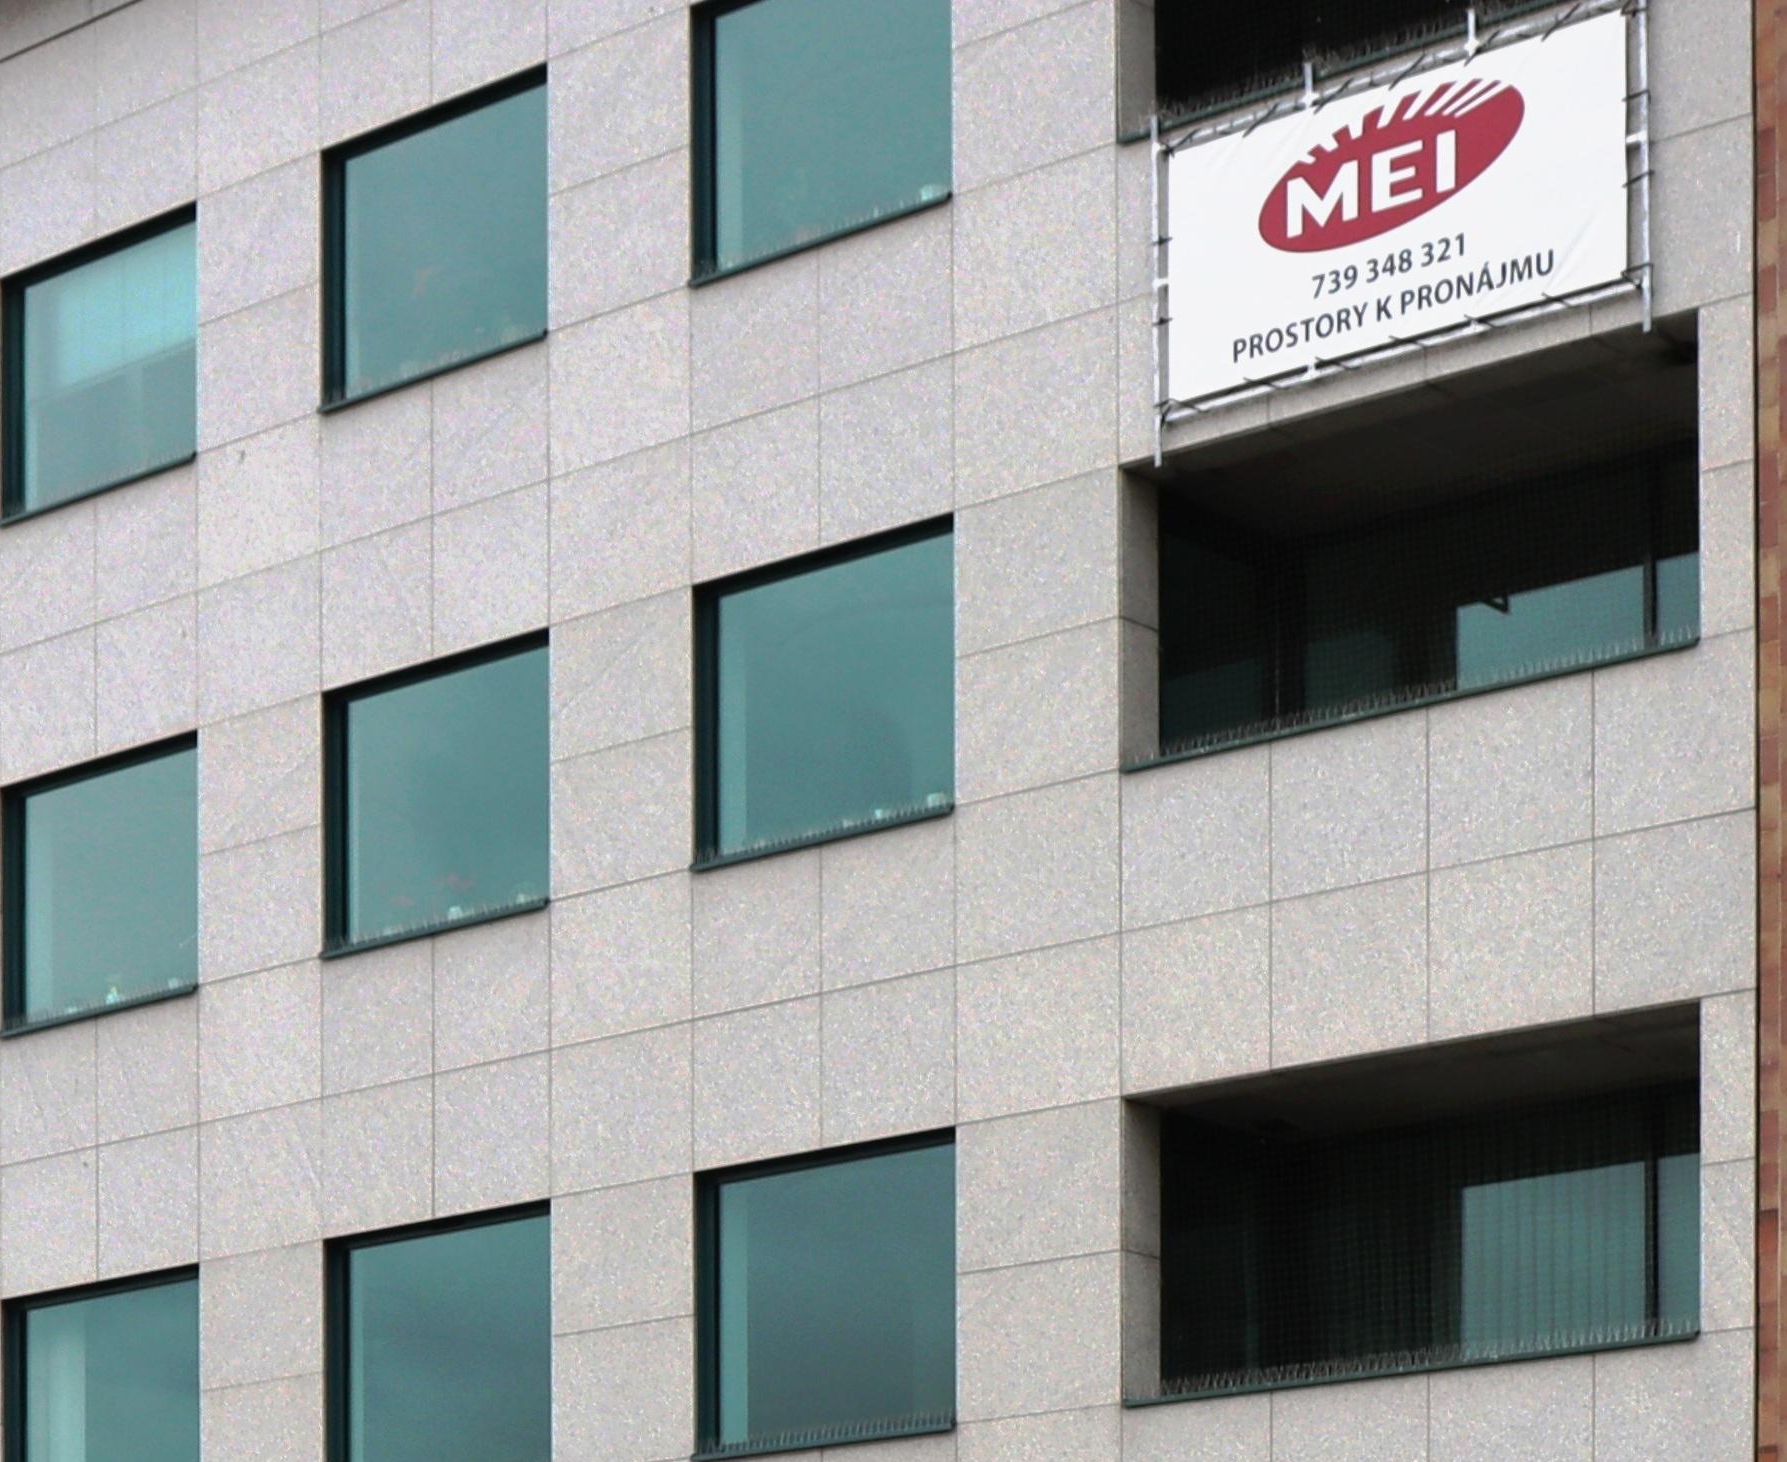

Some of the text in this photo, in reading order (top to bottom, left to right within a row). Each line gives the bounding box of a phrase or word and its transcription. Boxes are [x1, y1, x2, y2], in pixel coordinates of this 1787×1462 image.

[1286, 129, 1456, 239] MEI
[1232, 248, 1555, 363] PROSTORY K PRONÁJMU
[1312, 232, 1465, 299] 739 348 321
